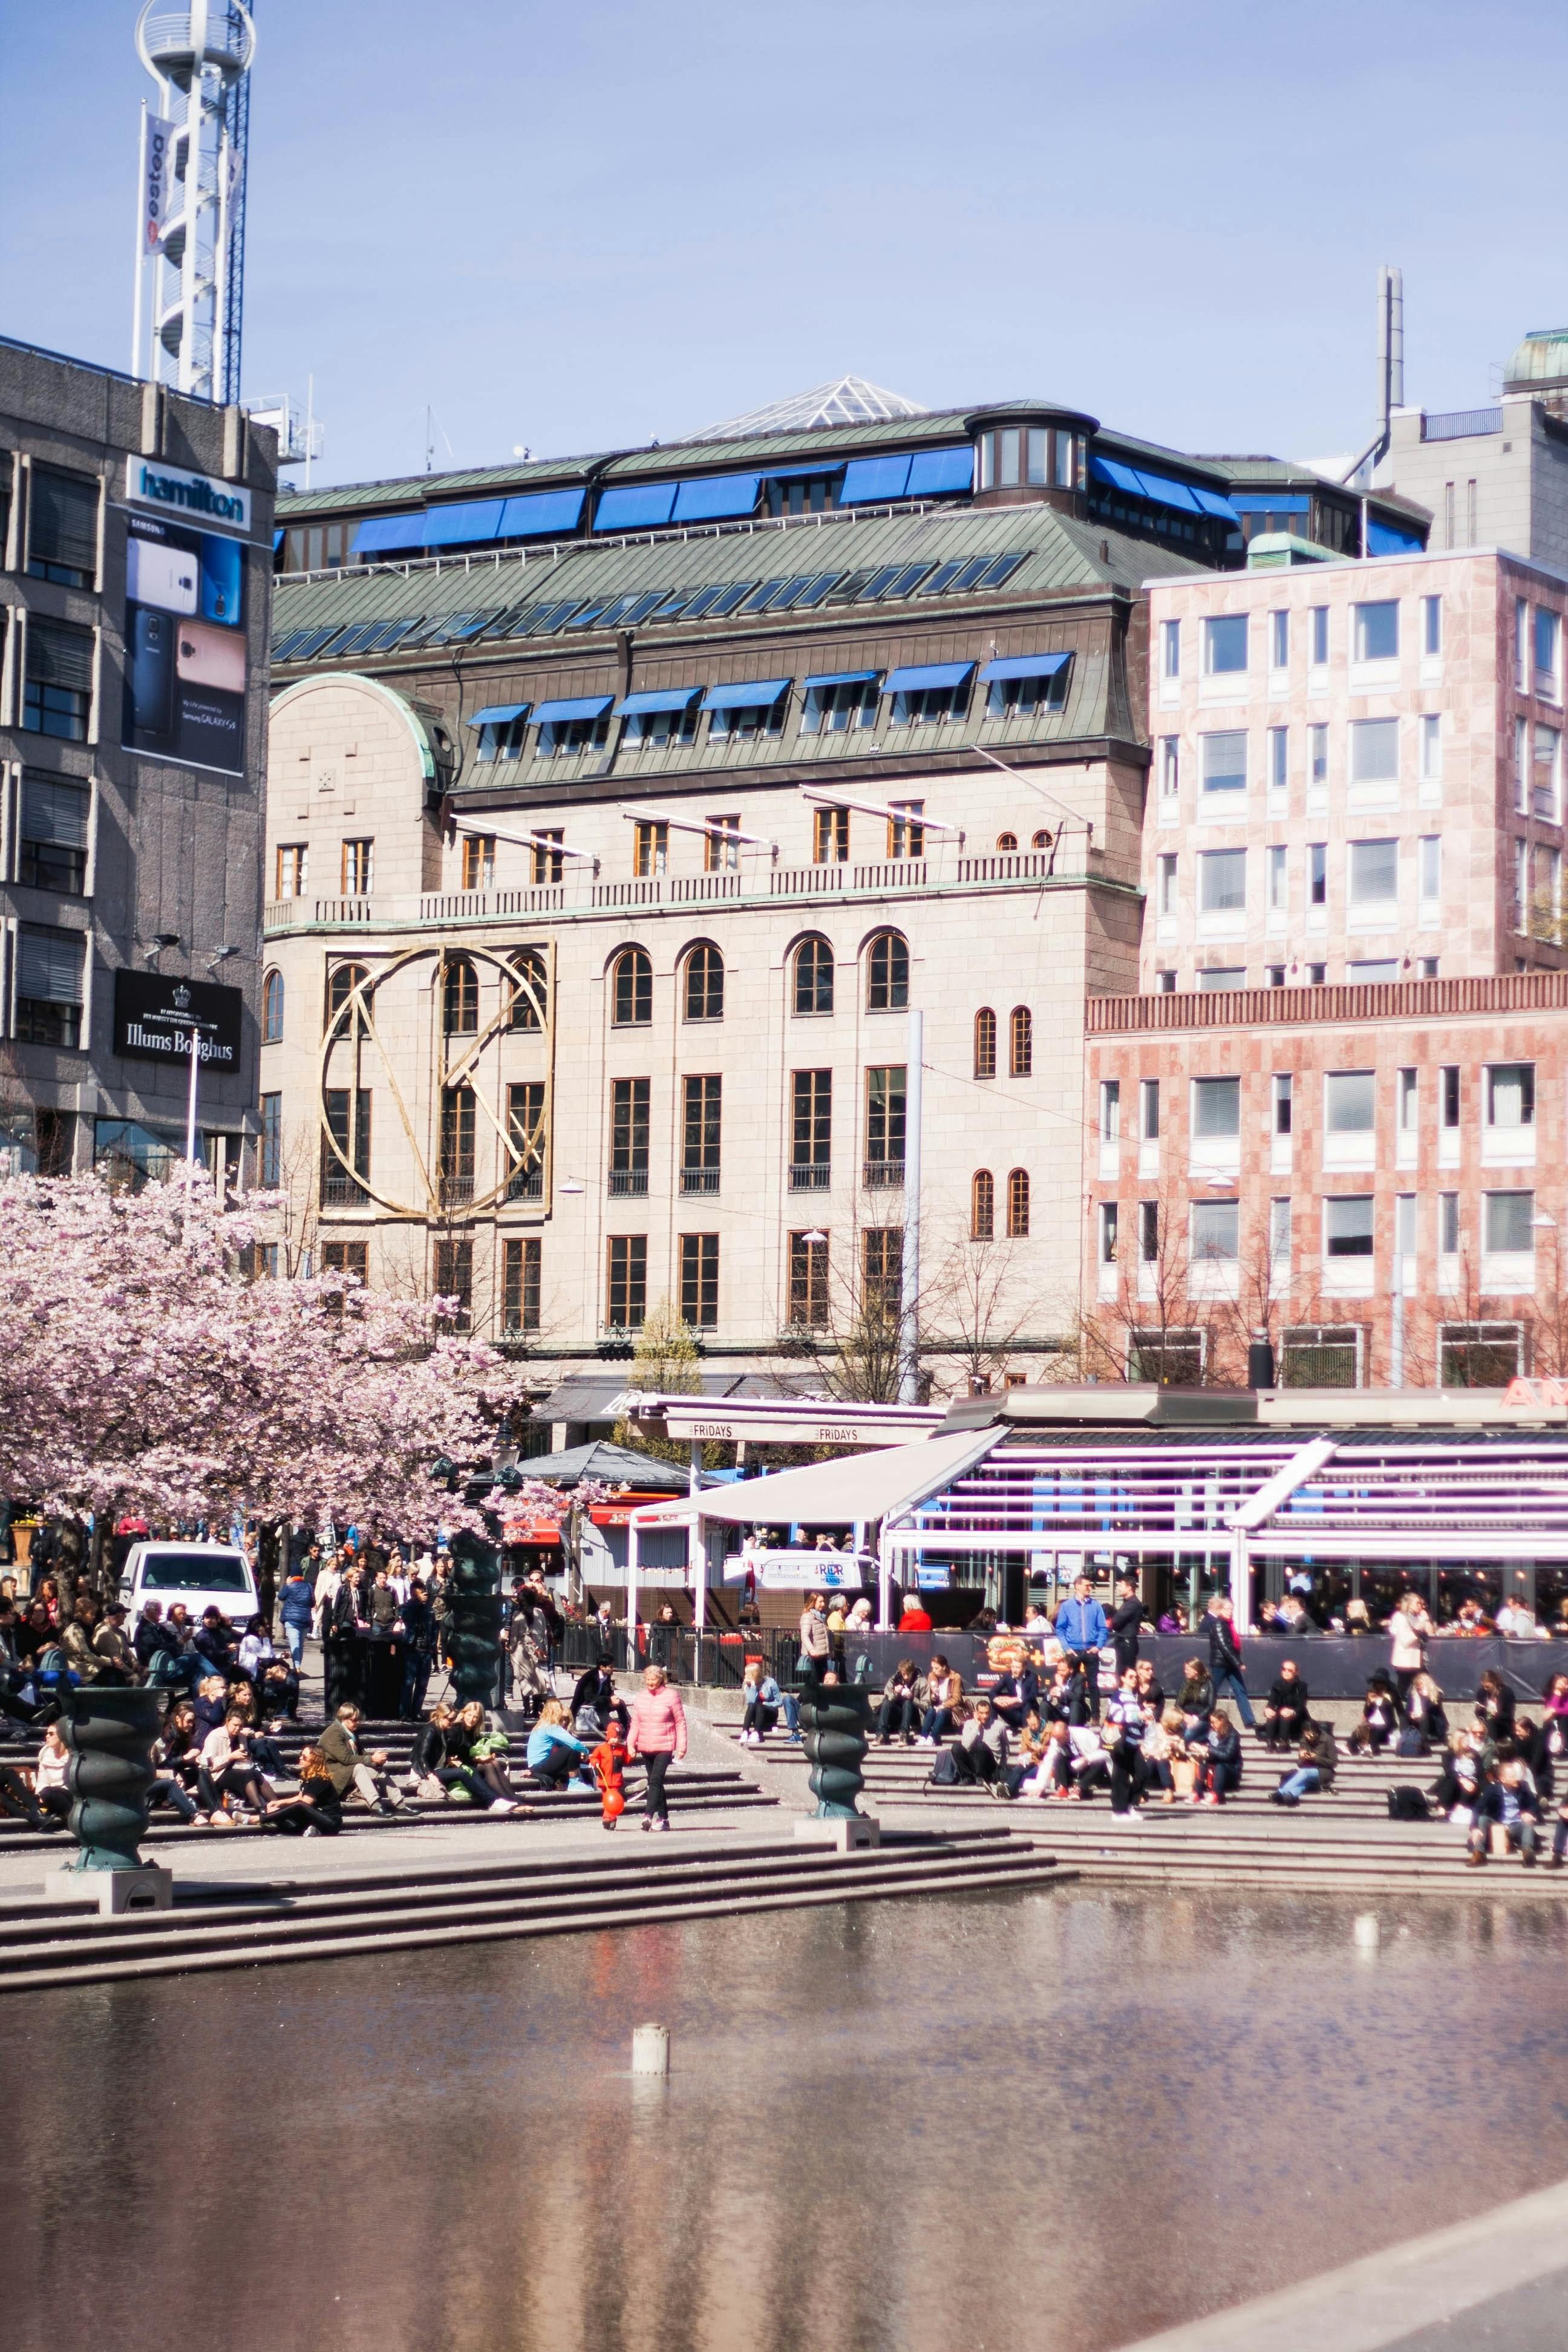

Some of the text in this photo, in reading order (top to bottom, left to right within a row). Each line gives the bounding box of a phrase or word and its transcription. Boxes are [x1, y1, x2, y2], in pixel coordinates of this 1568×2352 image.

[140, 465, 244, 523] hamilton
[131, 518, 165, 536] SAMSUNG
[126, 1024, 232, 1061] Illums Boighus
